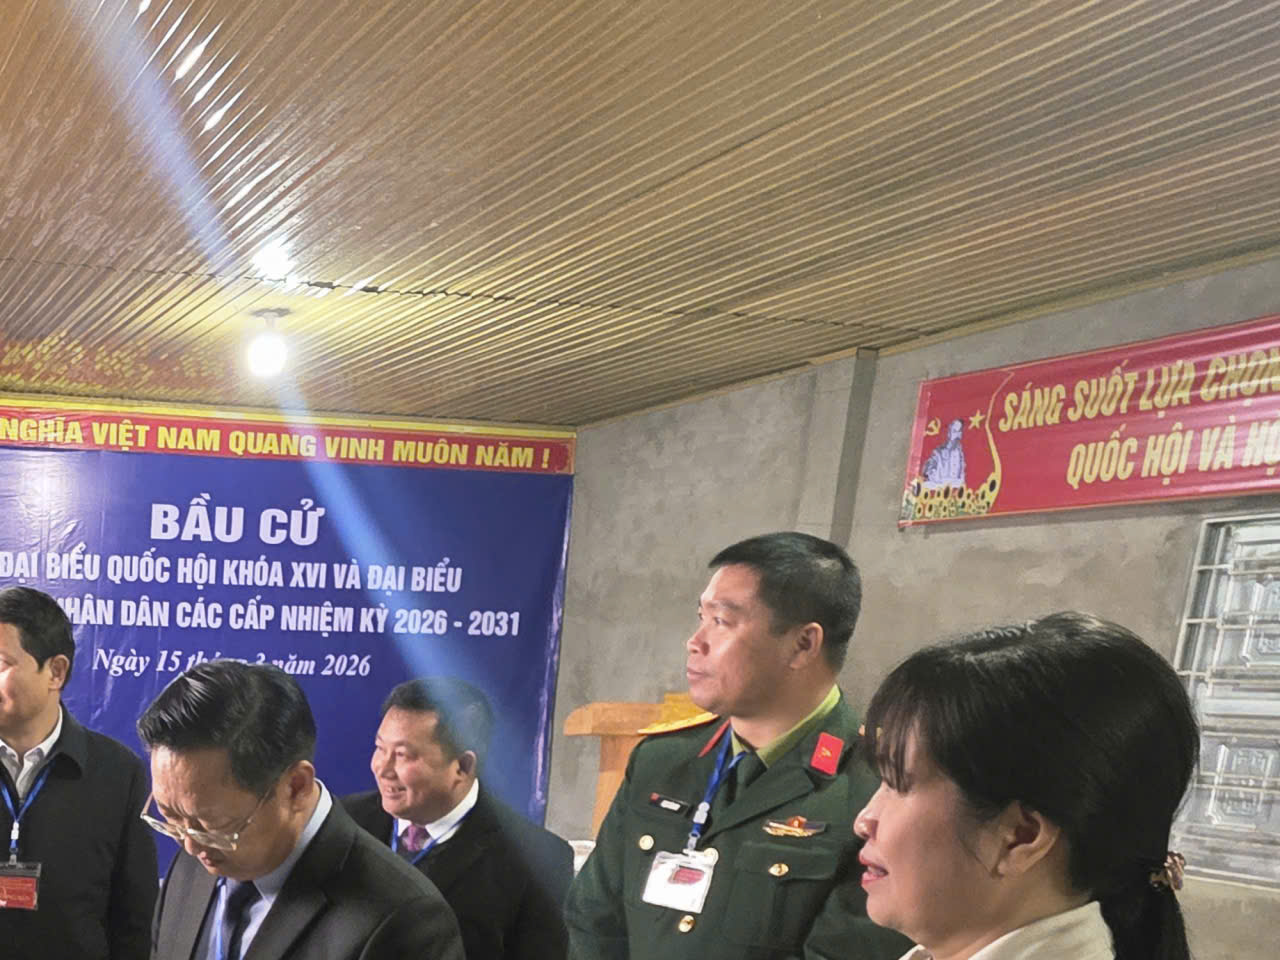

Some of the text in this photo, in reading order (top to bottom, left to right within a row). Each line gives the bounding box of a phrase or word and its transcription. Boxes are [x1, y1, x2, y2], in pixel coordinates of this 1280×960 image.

[999, 382, 1067, 432] SÁNG
[1067, 359, 1140, 422] SUỐT
[1139, 360, 1196, 418] LỰA
[91, 418, 151, 452] VIỆT
[156, 425, 221, 452] NAM
[228, 431, 318, 458] QUANG
[324, 436, 385, 462] VINH
[392, 439, 469, 465] MUÔN
[474, 442, 535, 469] NĂM
[541, 447, 551, 469] !
[1066, 423, 1139, 490] QUỐC
[1141, 422, 1194, 486] HỘI
[1198, 414, 1237, 472] VÀ
[150, 493, 326, 546] BẦU CỬ
[46, 542, 101, 581] BIỂU
[106, 548, 171, 585] QUỐC
[176, 552, 217, 590] HỘI
[222, 555, 284, 587] KHÓA
[289, 561, 327, 589] XVI
[333, 558, 361, 589] VÀ
[367, 564, 406, 597] ĐẠI
[410, 558, 463, 593] BIỂU
[122, 595, 169, 628] DÂN
[175, 597, 223, 629] CÁC
[228, 594, 275, 630] CẤP
[280, 600, 354, 638] NHIỆM
[359, 602, 390, 634] KỲ
[393, 608, 448, 635] 2026
[467, 610, 520, 636] 2031
[92, 648, 151, 677] Ngày
[155, 650, 182, 672] 15
[321, 654, 371, 676] 2026
